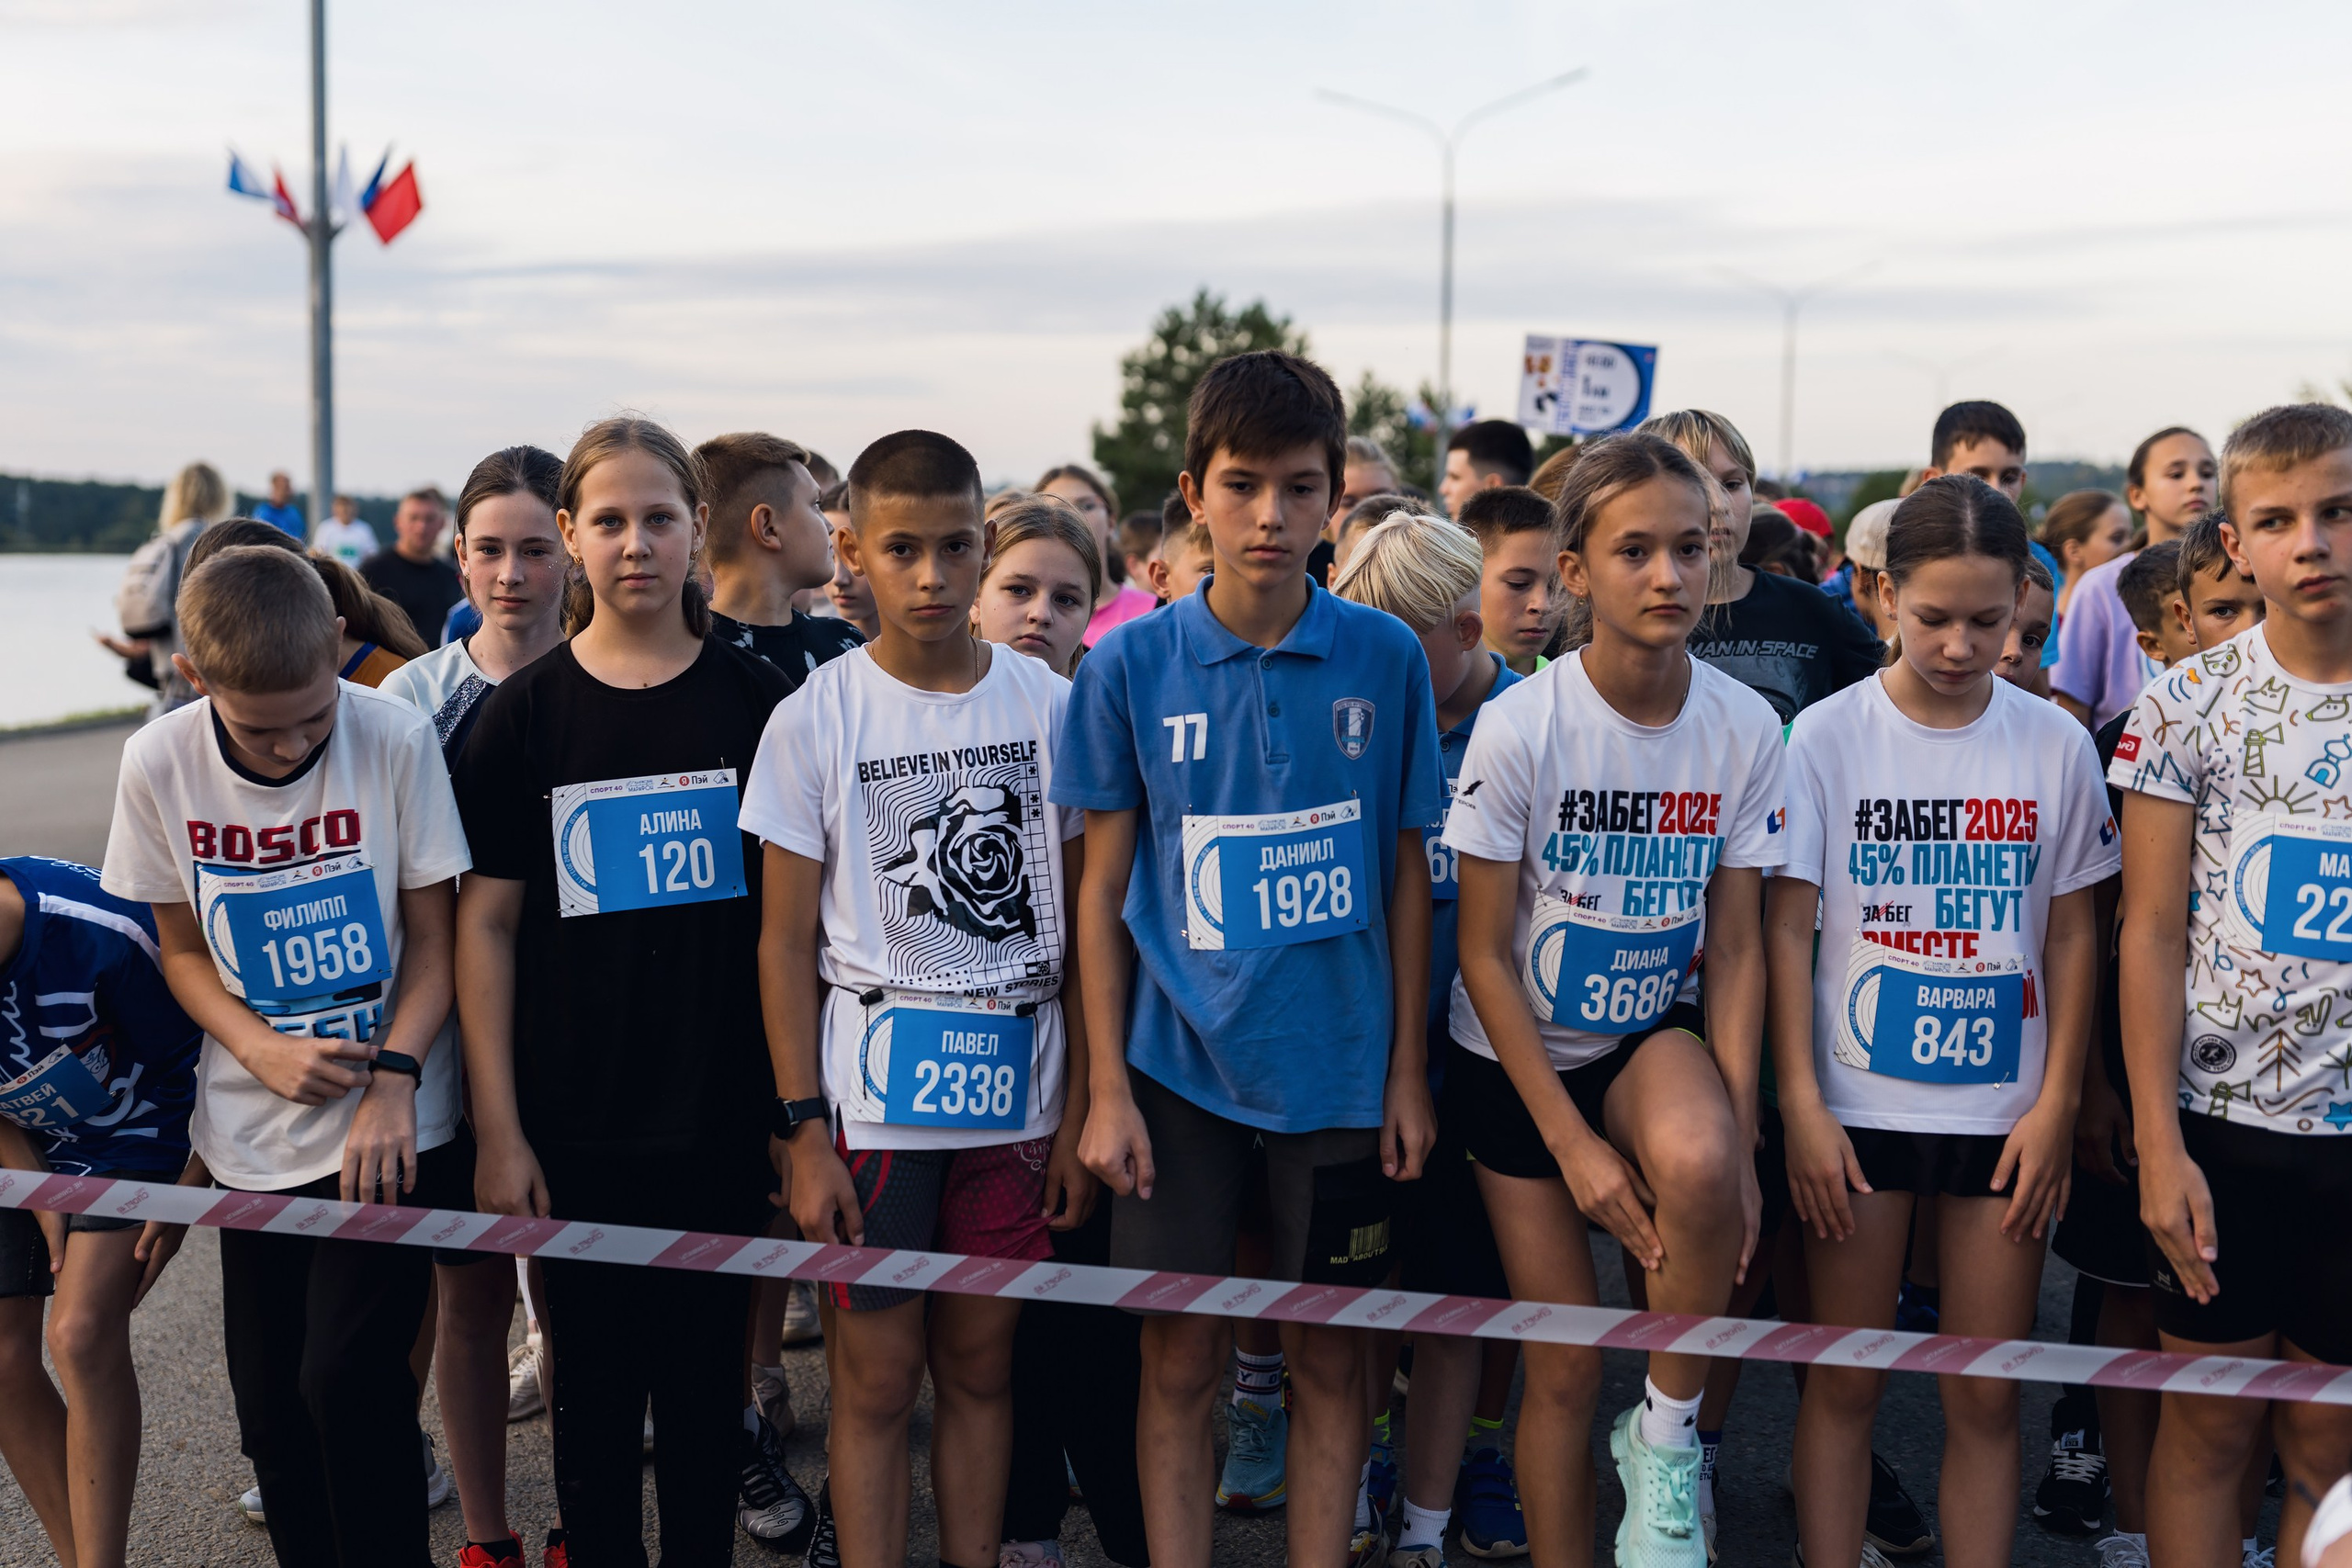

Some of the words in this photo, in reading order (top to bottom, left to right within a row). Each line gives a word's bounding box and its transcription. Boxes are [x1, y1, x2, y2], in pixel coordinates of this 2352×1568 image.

[1735, 640, 1758, 657] IN
[1758, 640, 1819, 660] SPACE
[1163, 713, 1207, 762] 77
[857, 753, 930, 783] BELIEVE
[933, 751, 950, 773] IN
[952, 740, 1036, 770] YOURSELF
[692, 775, 707, 784] Пэй
[640, 808, 702, 835] АЛИНА
[1321, 811, 1336, 822] Пэй
[1854, 798, 2039, 842] #ЗАБЕГ2025
[187, 808, 361, 864] BOSCO
[639, 838, 716, 895] 120
[1260, 838, 1334, 872] ДАНИИЛ
[1542, 831, 1601, 877] 45%
[1849, 842, 1905, 886] 45%
[1912, 842, 2041, 886] ПЛАНЕТЫ
[2319, 852, 2352, 878] МА
[264, 895, 348, 931] ФИЛИПП
[1252, 866, 1352, 930] 1928
[1936, 888, 2023, 932] БЕГУТ
[1671, 914, 1685, 925] Пэй
[262, 922, 372, 988] 1958
[1611, 947, 1668, 972] ДИАНА
[1861, 931, 1979, 959] ЕСТЕ
[1987, 962, 2001, 972] Пэй
[964, 986, 999, 998] NEW
[1005, 976, 1058, 994] STORIES
[1580, 968, 1679, 1023] 3686
[1917, 985, 1996, 1010] ВАРВАРА
[998, 1000, 1011, 1010] Пэй
[942, 1031, 999, 1055] ПАВЕЛ
[1912, 1015, 1995, 1066] 843
[0, 1082, 57, 1110] АТВЕЙ
[912, 1060, 1015, 1117] 2338
